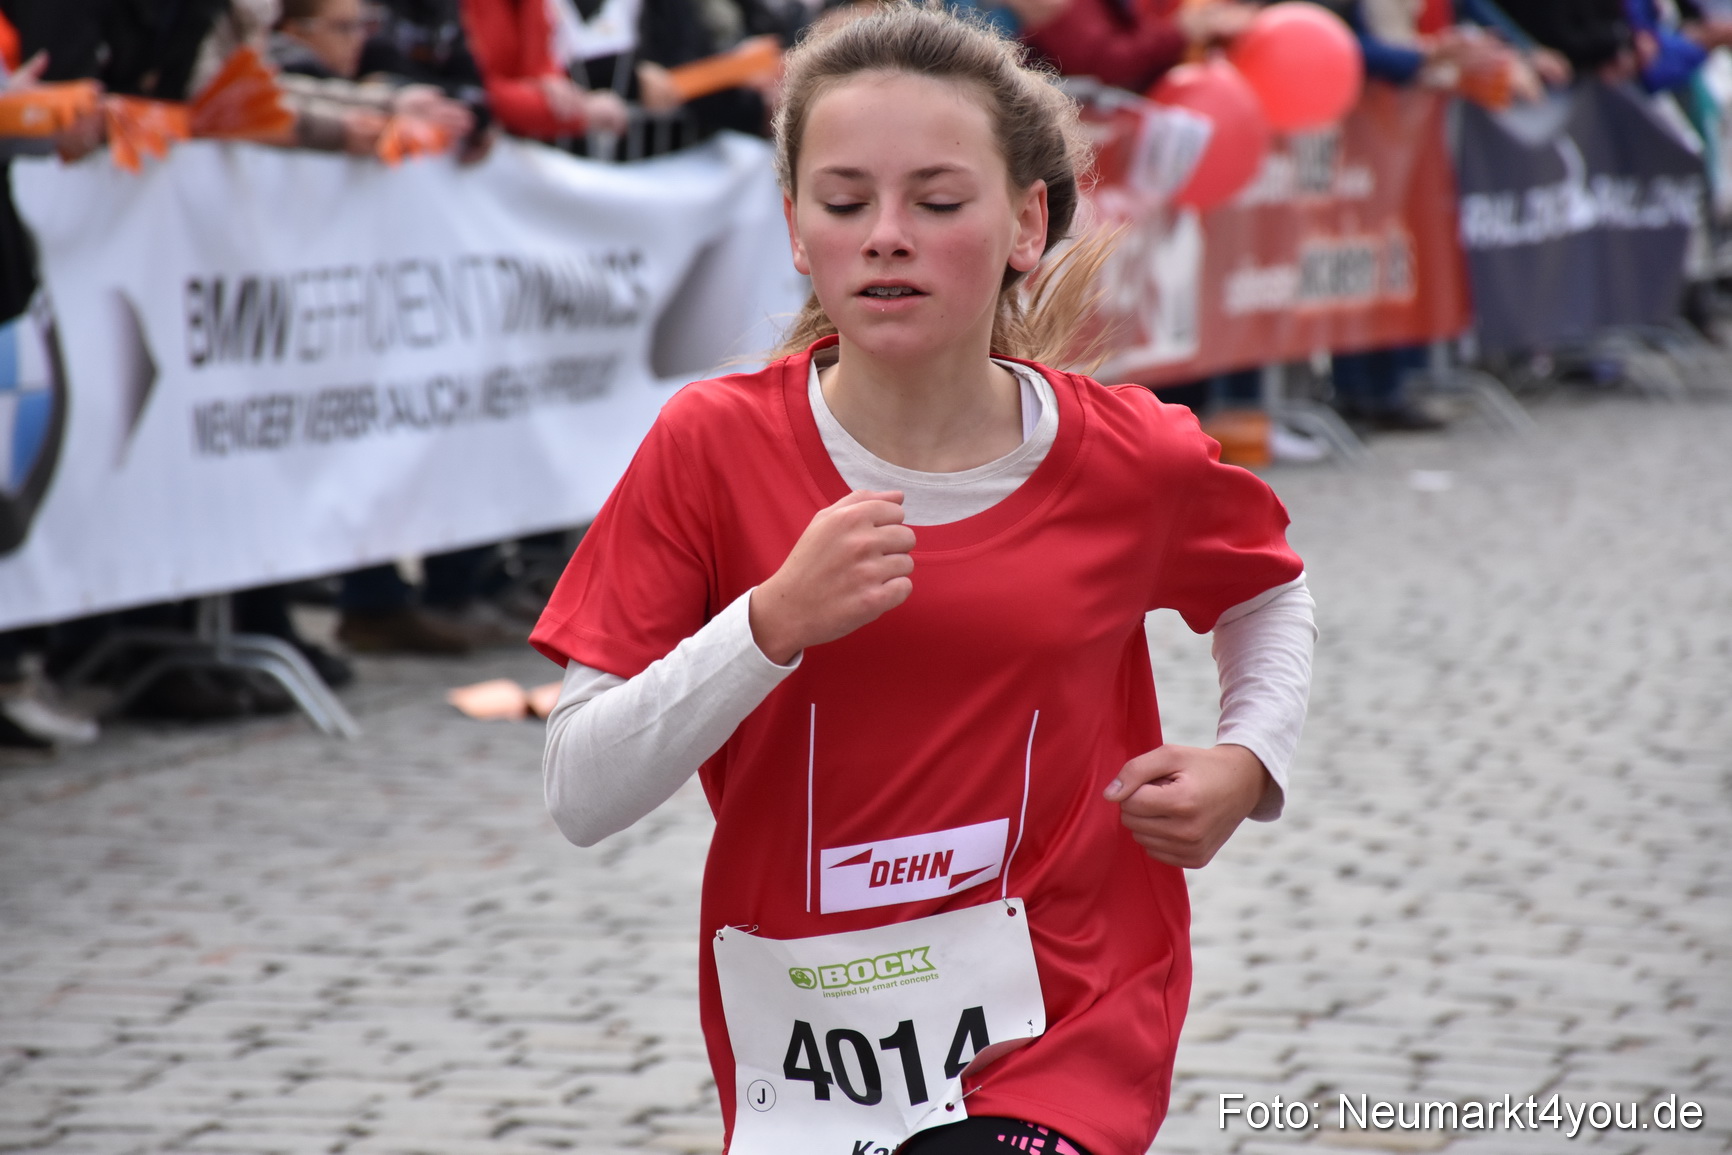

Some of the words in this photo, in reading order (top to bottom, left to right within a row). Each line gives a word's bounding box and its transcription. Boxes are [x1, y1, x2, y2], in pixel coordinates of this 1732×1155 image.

[184, 272, 291, 368] BMW
[868, 849, 954, 888] DEHN
[818, 946, 937, 989] BOCK
[822, 988, 858, 999] inspired
[859, 985, 871, 995] by
[872, 980, 898, 991] smart
[900, 973, 940, 986] concepts
[783, 1005, 991, 1106] 4014
[757, 1088, 766, 1105] J
